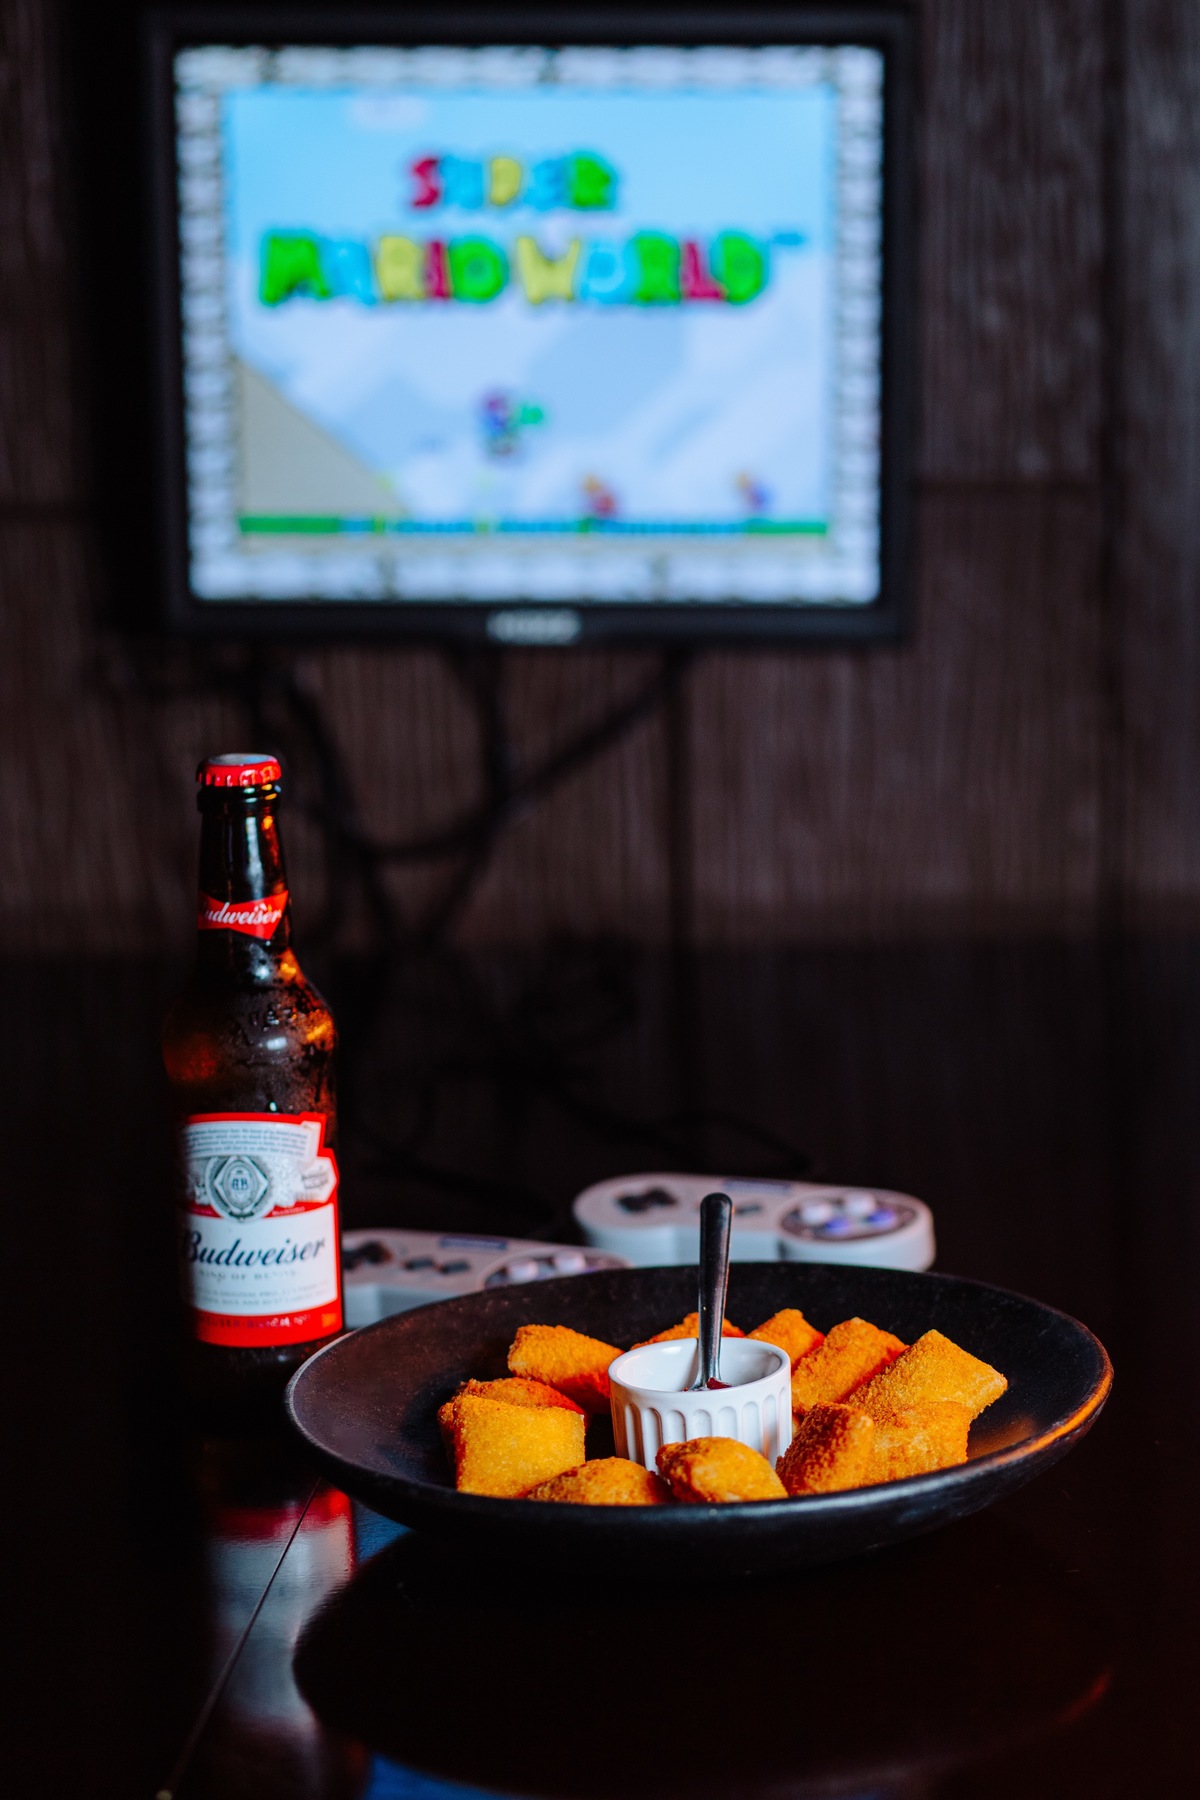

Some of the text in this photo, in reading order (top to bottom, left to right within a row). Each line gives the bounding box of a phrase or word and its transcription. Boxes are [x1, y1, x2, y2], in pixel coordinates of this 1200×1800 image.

[408, 151, 618, 211] SUPER
[260, 229, 770, 306] MARIO WORLD
[205, 902, 282, 925] udweiser
[185, 1229, 325, 1266] Budweiser
